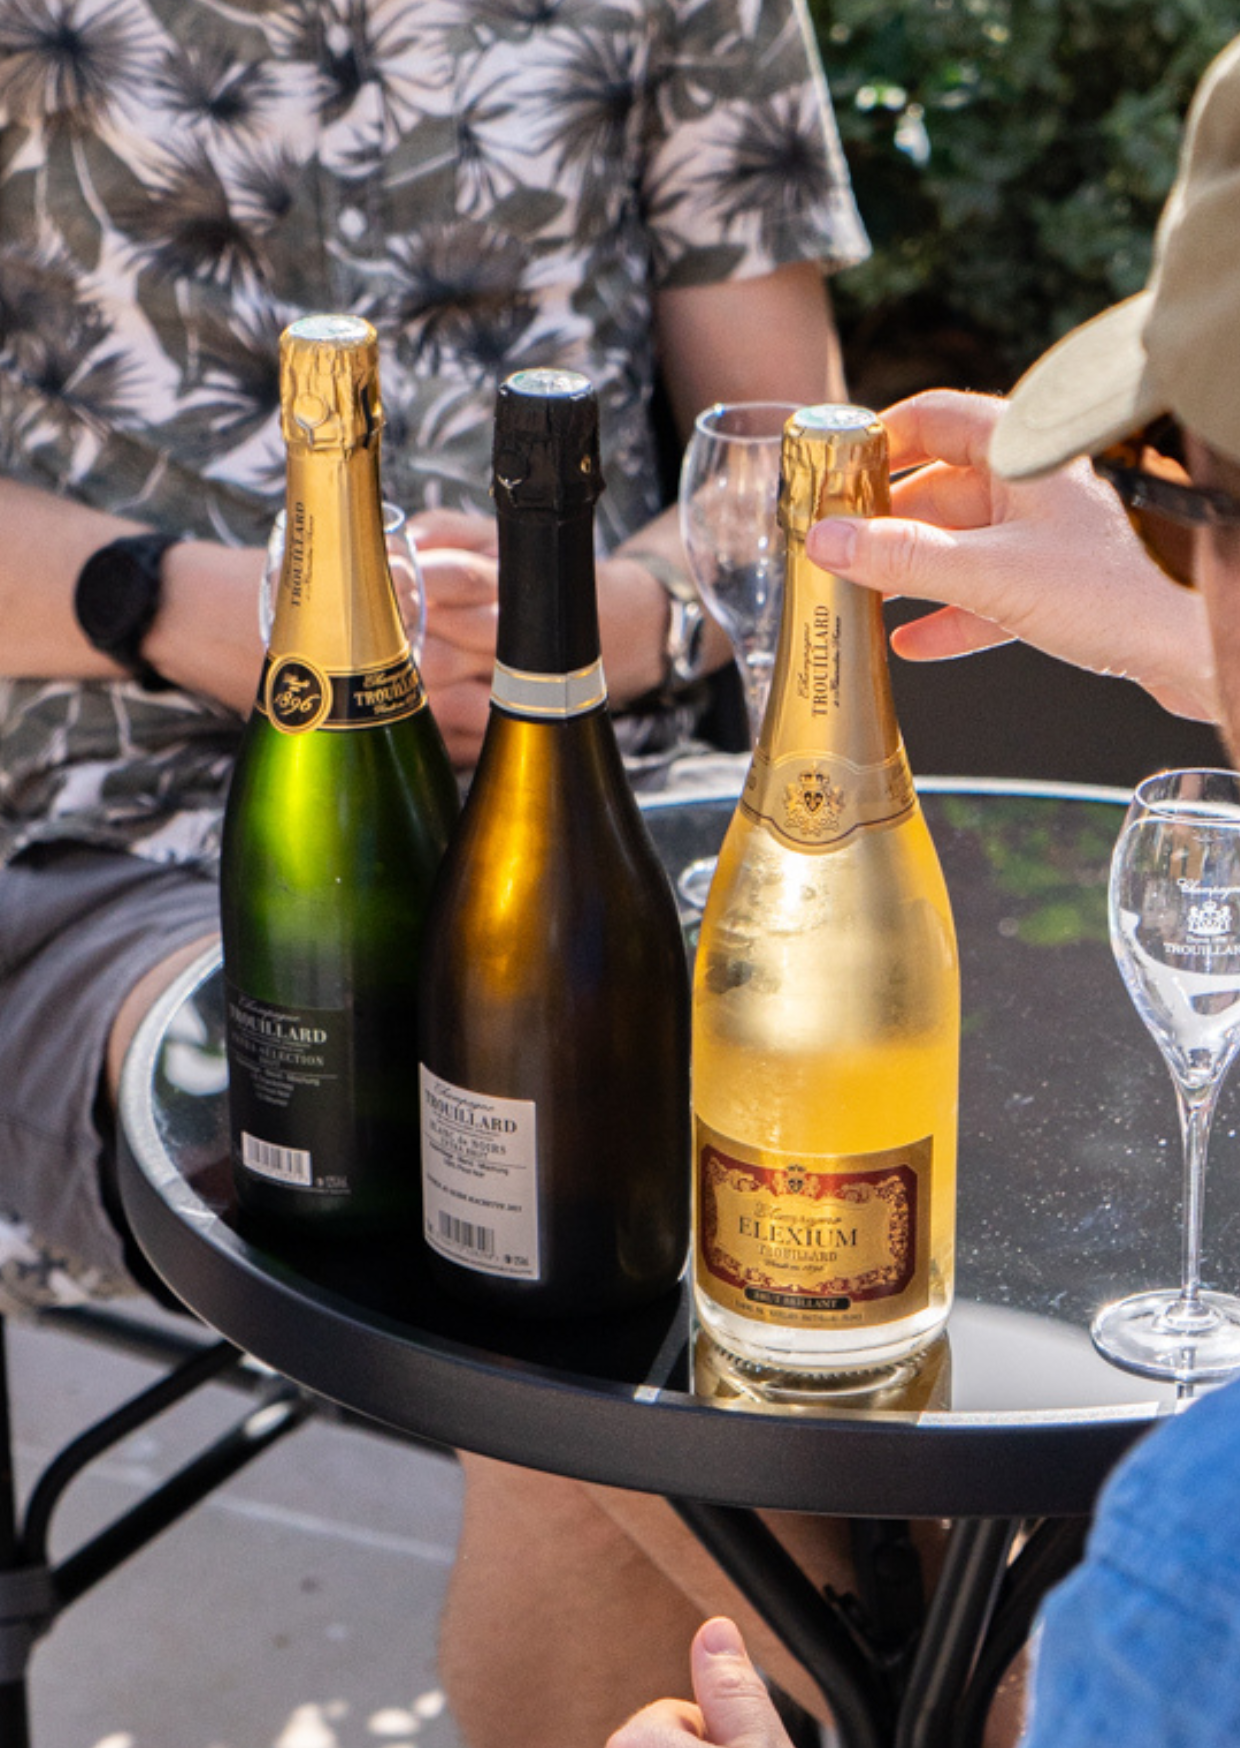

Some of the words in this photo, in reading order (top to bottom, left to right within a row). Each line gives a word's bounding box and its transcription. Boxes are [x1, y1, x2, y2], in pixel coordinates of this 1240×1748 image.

[812, 605, 830, 717] TROUILLARD
[425, 1088, 518, 1134] TROUILLARD
[739, 1215, 858, 1247] ELEXIUM
